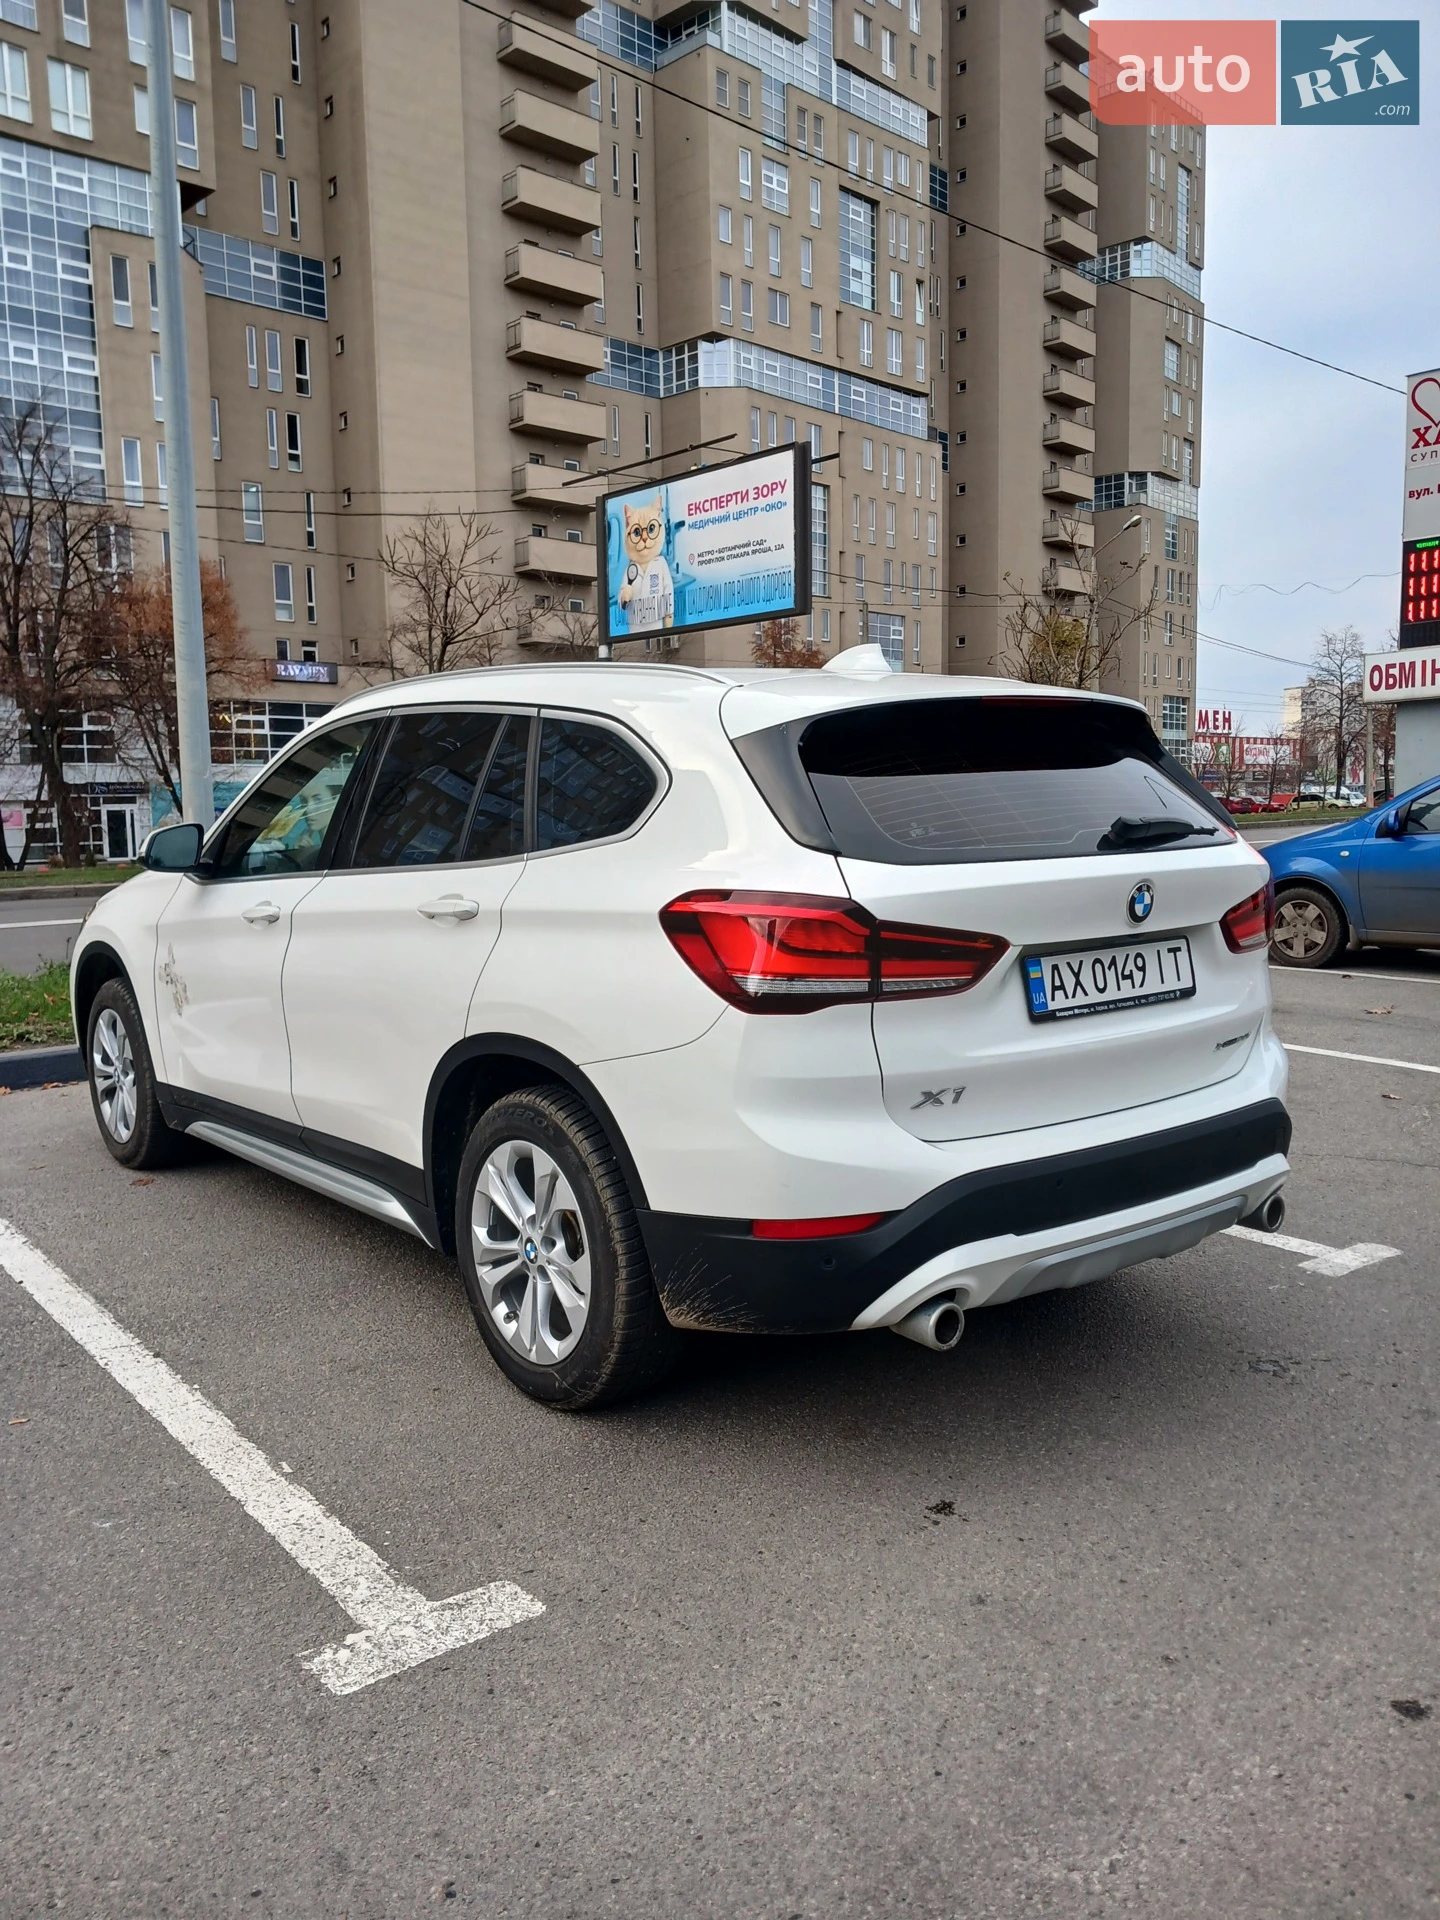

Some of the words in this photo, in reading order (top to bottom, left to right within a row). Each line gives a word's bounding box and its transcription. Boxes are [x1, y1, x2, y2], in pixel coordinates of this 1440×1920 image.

[687, 489, 749, 517] ЕКСПЕРТИ
[752, 478, 788, 501] ЗОРУ
[687, 512, 731, 531] МЕДИЧНИЙ
[732, 506, 759, 522] ЦЕНТР
[760, 500, 788, 513] «ОКО»
[697, 548, 715, 559] МЕТРО
[697, 555, 726, 567] ПРОВУЛОК
[726, 550, 750, 561] ОТАКАРА
[751, 546, 773, 556] ЯРОША,
[774, 543, 785, 551] 12А
[737, 576, 760, 608] ВАШОГО
[1032, 992, 1046, 1005] UA
[910, 1086, 967, 1110] X1
